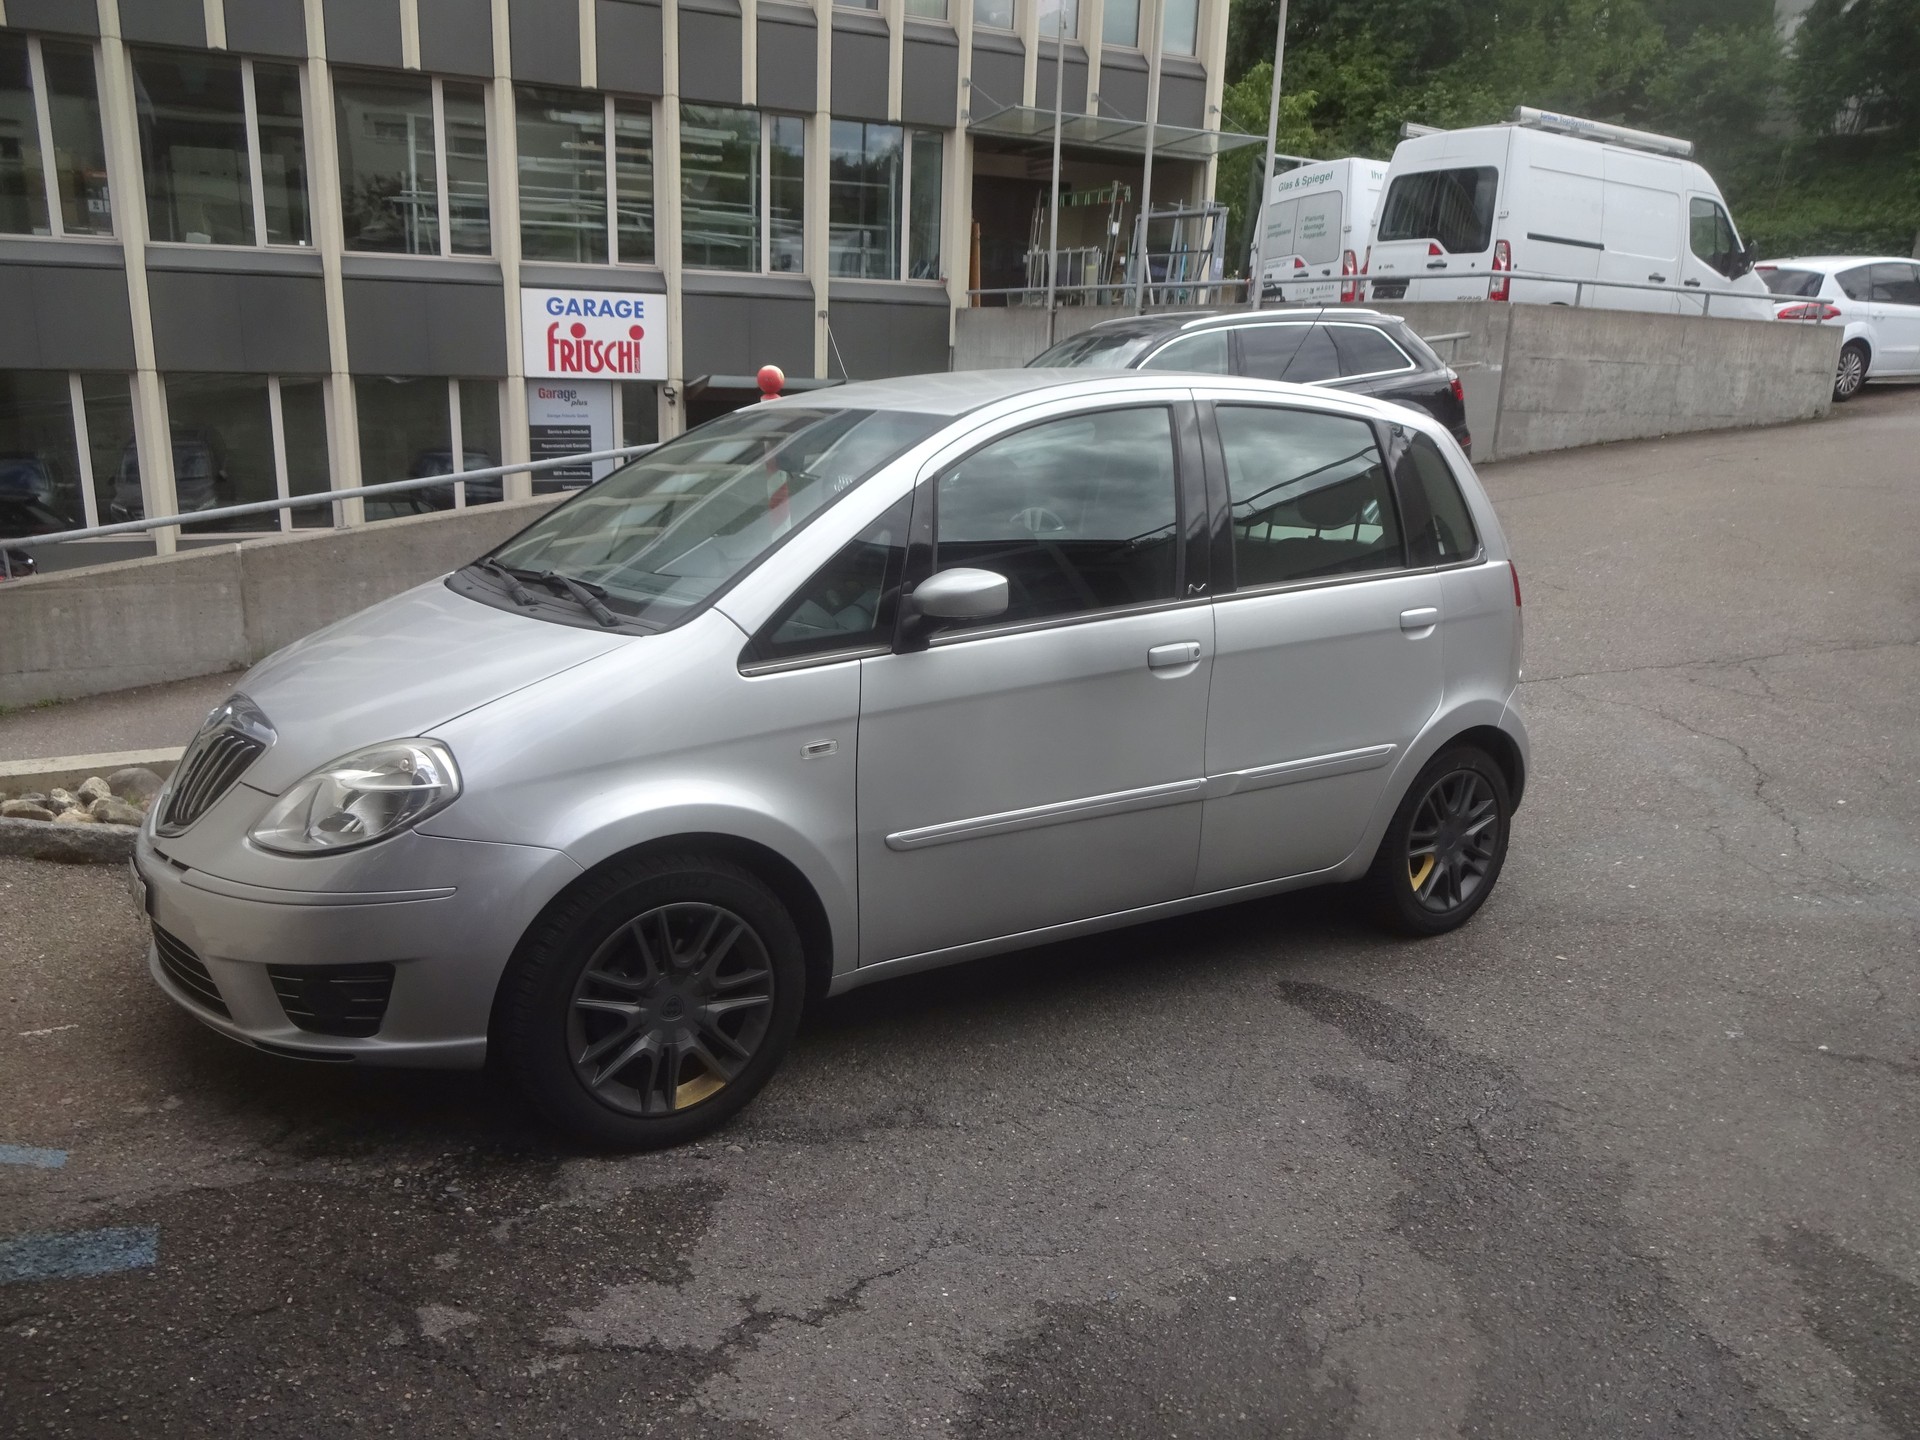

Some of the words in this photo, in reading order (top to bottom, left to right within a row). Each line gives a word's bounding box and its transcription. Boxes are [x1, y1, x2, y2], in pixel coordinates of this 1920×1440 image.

[1278, 181, 1293, 192] Glas
[1294, 177, 1301, 187] &
[1302, 170, 1334, 187] Spiegel
[1370, 170, 1383, 180] Ihr
[546, 296, 644, 319] GARAGE
[538, 387, 577, 404] Garage
[571, 398, 588, 407] plus
